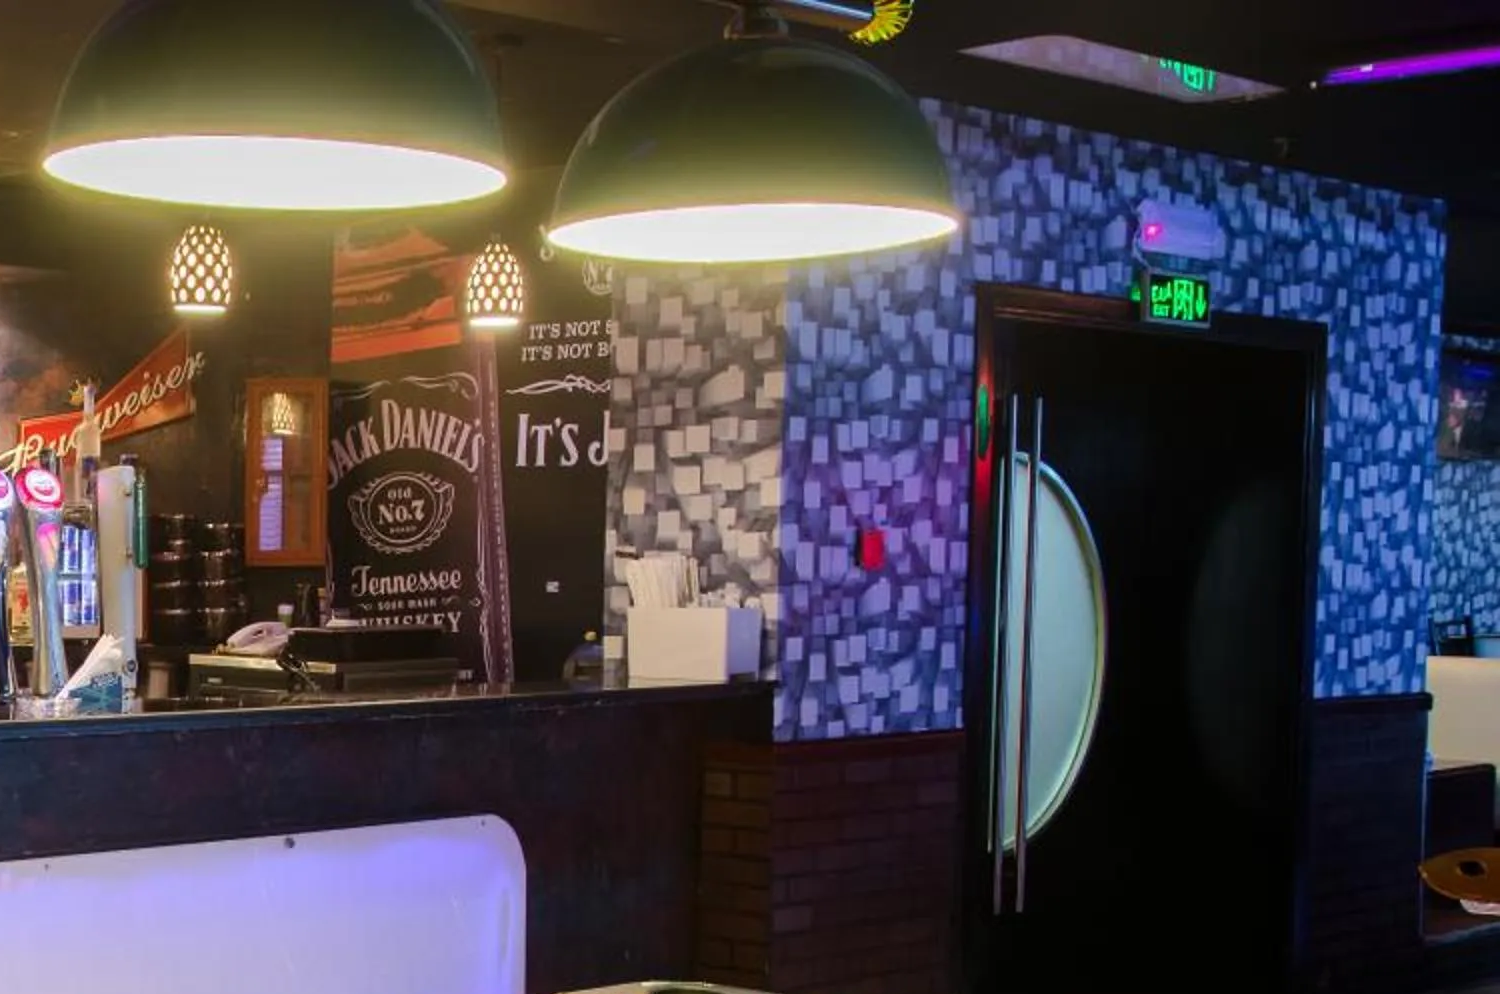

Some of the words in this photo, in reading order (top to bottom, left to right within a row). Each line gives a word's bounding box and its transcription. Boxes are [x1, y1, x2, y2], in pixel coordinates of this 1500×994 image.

[529, 323, 561, 340] IT'S
[565, 320, 601, 338] NOT
[521, 344, 553, 362] IT'S
[557, 342, 593, 360] NOT
[327, 415, 381, 490] JACK
[381, 399, 485, 473] DANIEL'S
[516, 413, 579, 467] IT'S
[388, 487, 412, 500] Old
[351, 565, 462, 597] Tennessee
